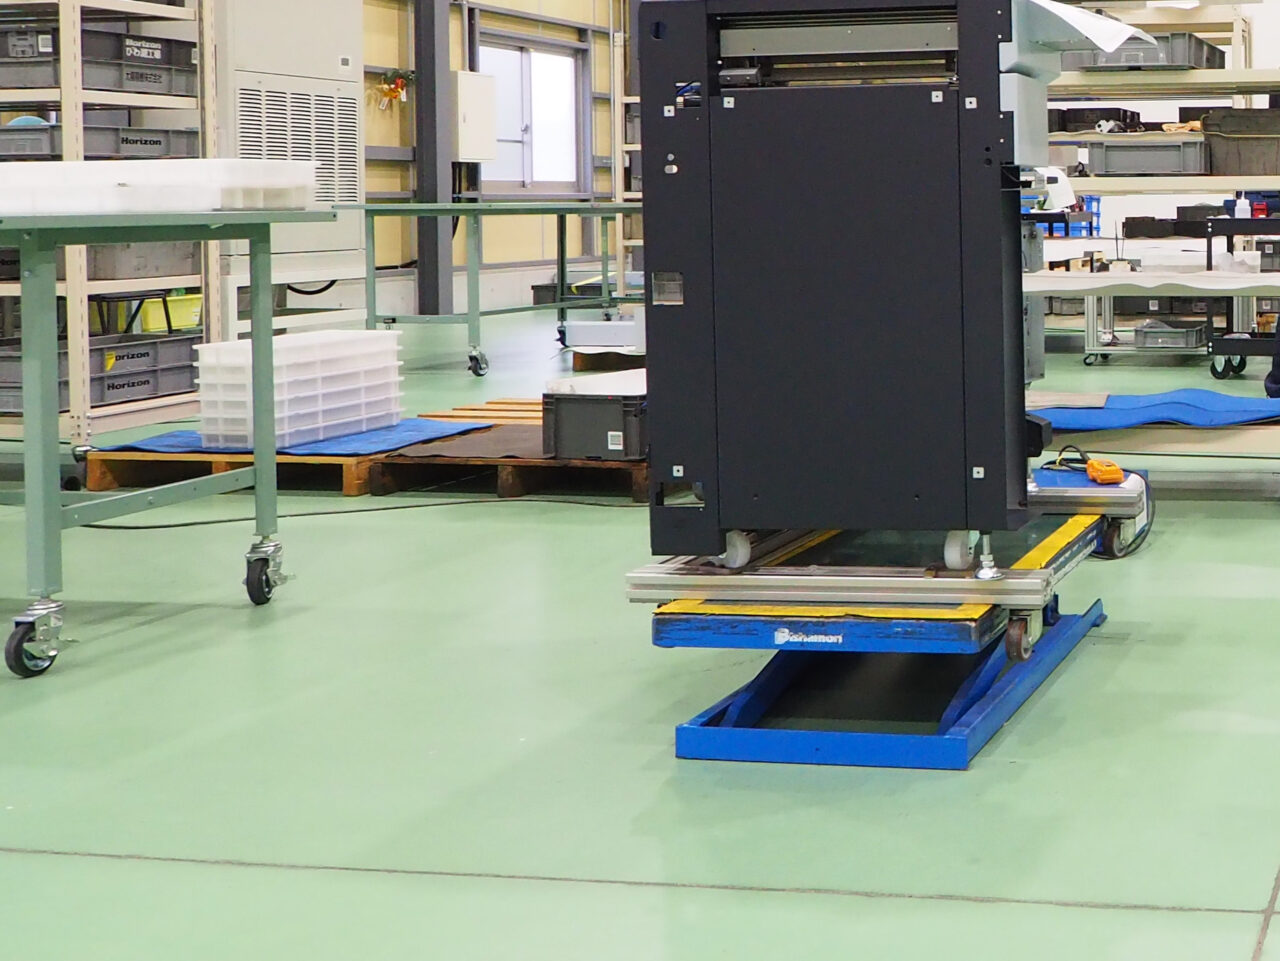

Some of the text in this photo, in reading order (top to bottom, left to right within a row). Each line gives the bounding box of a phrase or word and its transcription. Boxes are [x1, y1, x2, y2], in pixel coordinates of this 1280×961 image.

[121, 136, 162, 146] Horizon
[115, 351, 150, 361] orizon
[106, 379, 150, 391] Horizon
